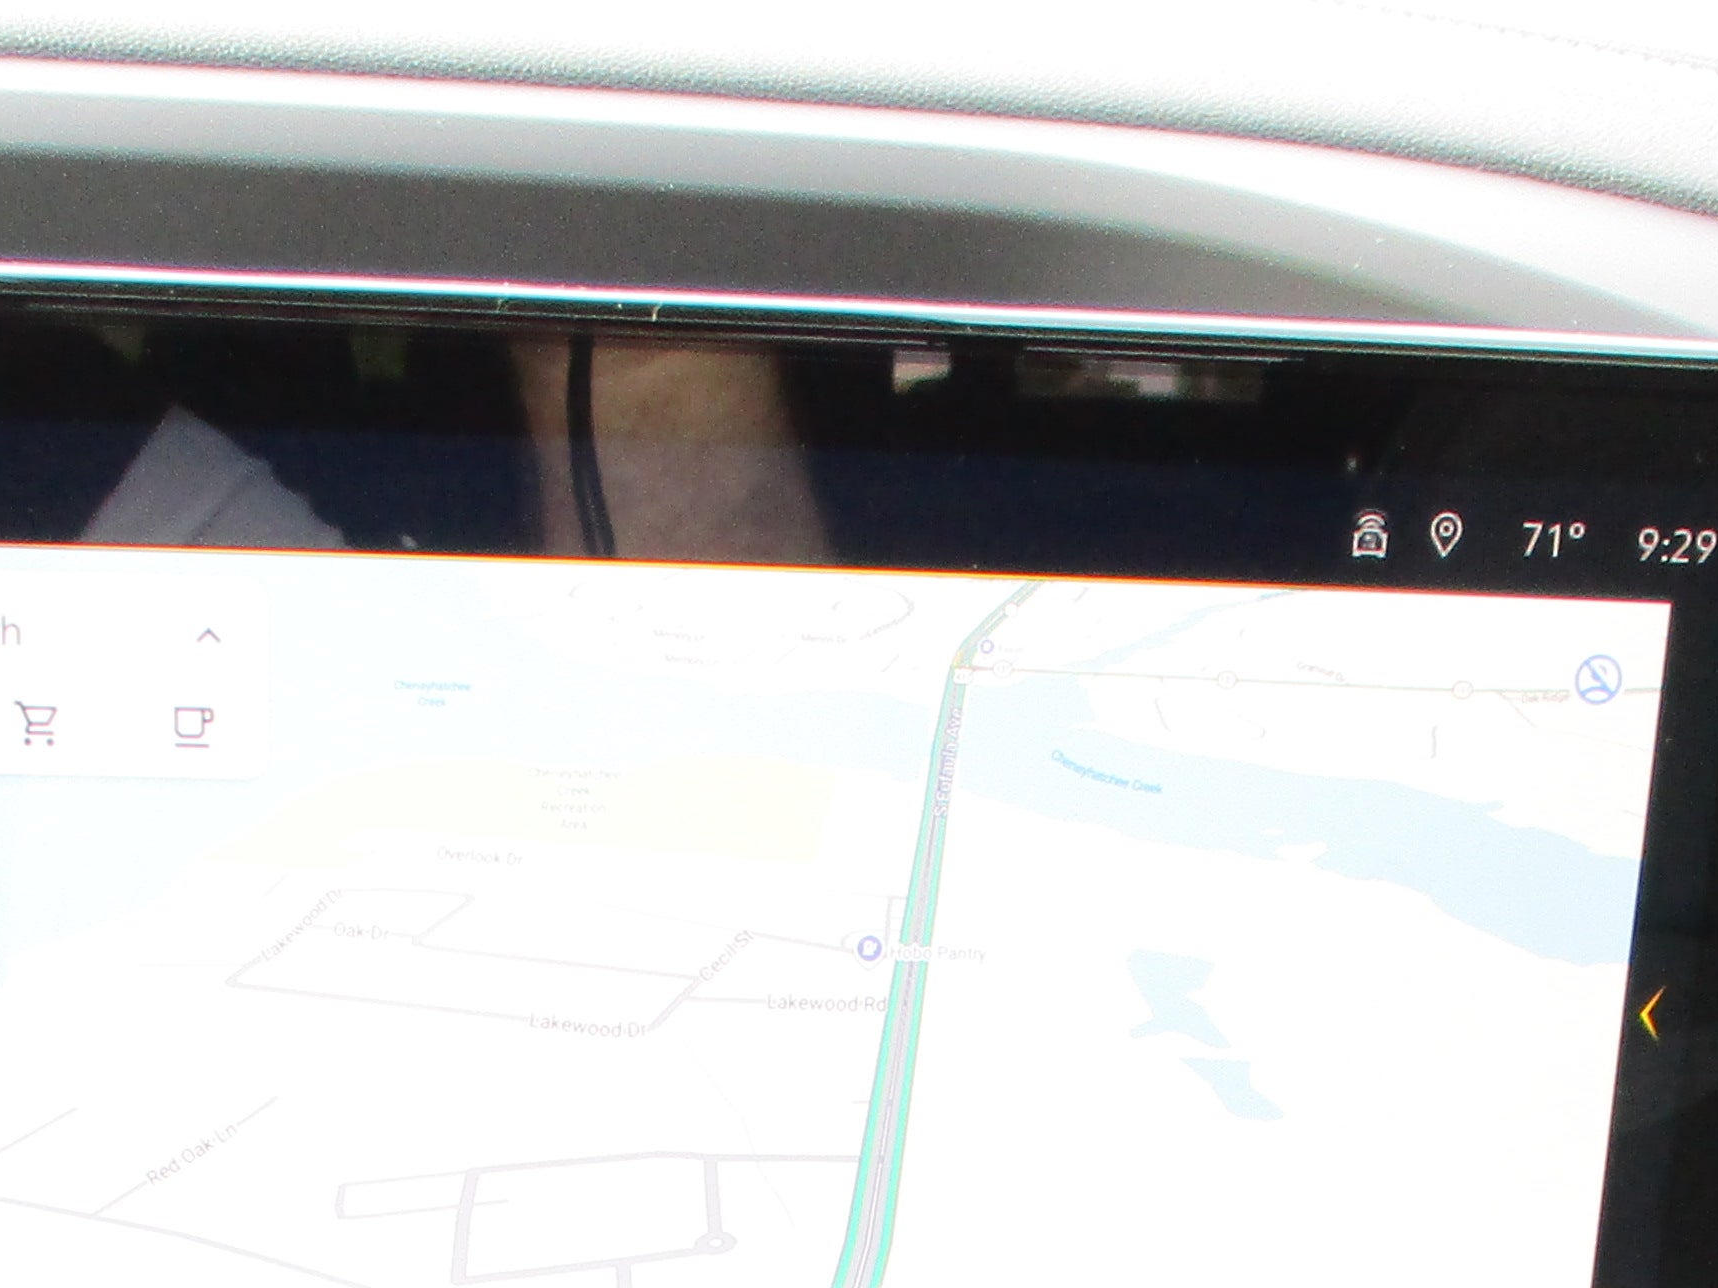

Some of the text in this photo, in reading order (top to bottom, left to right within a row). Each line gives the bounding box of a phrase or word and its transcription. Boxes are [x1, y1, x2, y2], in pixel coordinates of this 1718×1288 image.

[1522, 520, 1718, 564] 71° 9:29
[333, 921, 390, 941] Oak Dr
[937, 947, 987, 965] Pantry
[766, 994, 888, 1013] Lakewood Rd
[528, 1013, 650, 1039] Lakewood Dr
[145, 1155, 181, 1188] Red
[181, 1136, 216, 1167] Oak
